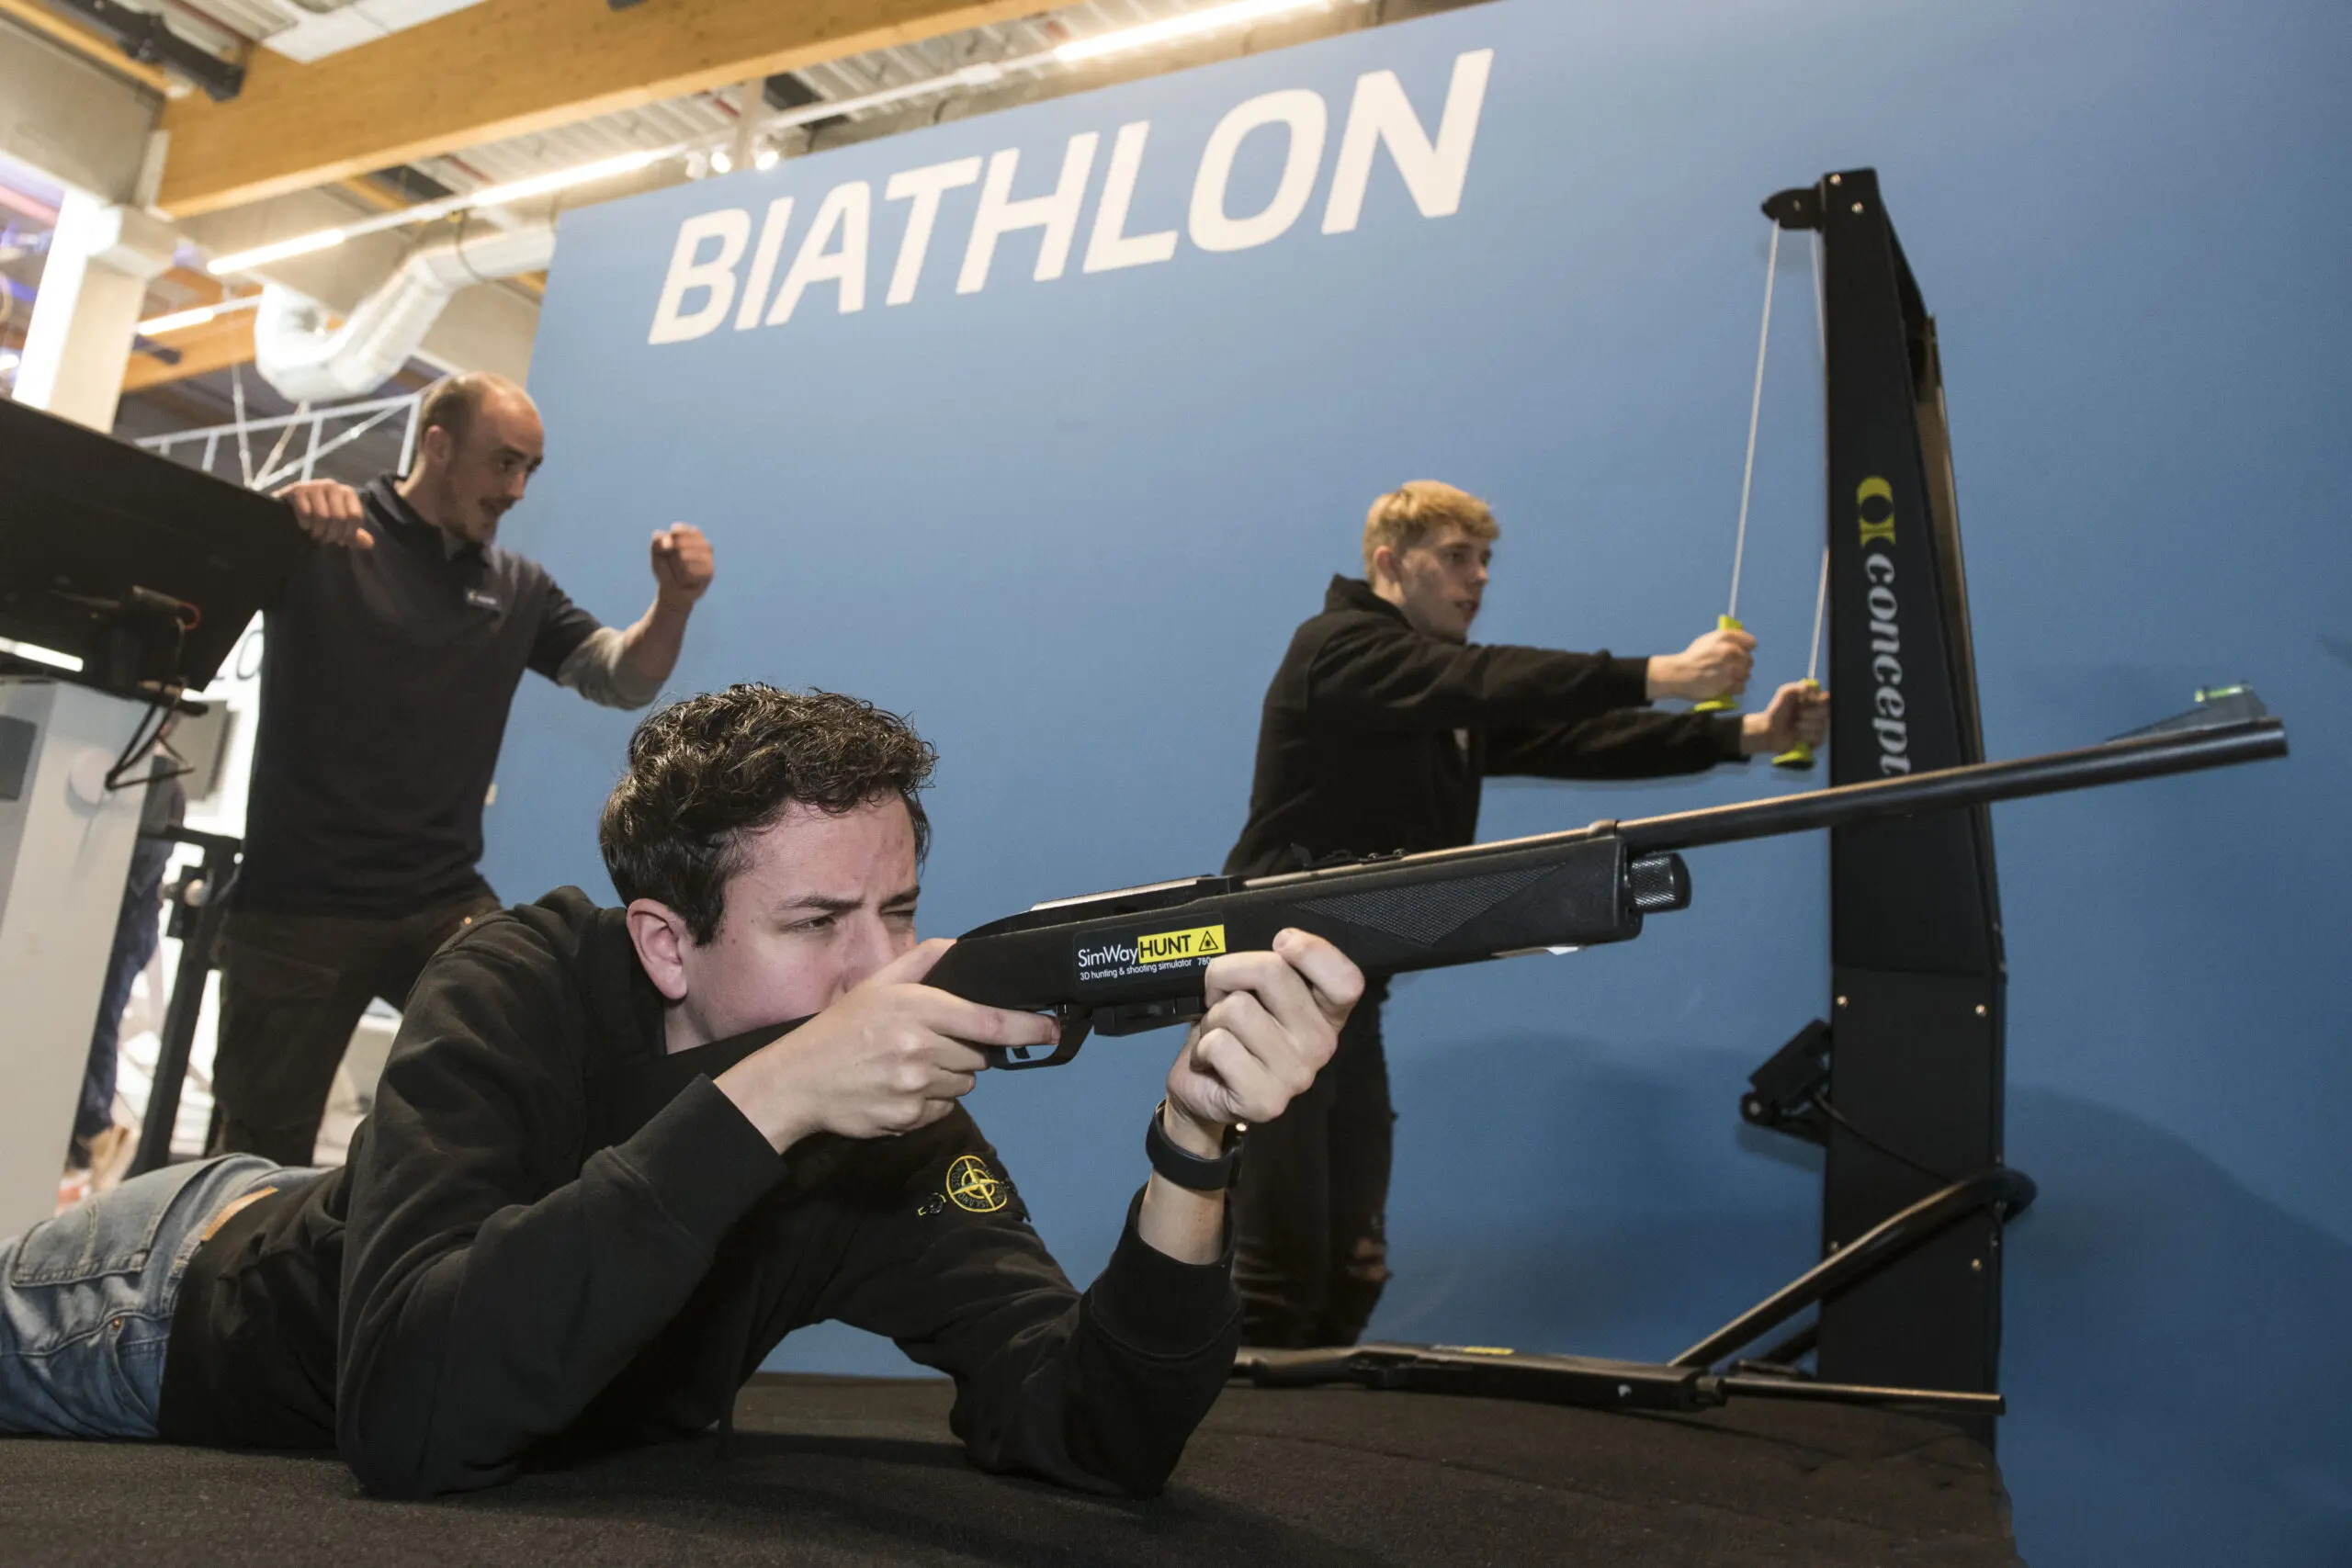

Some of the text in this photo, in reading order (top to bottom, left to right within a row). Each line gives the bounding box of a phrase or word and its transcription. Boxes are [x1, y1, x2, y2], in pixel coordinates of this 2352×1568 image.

[648, 49, 1495, 344] BIATHLON
[1865, 553, 1911, 776] concept
[1080, 956, 1212, 981] 3D hunting & shooting simulator 780
